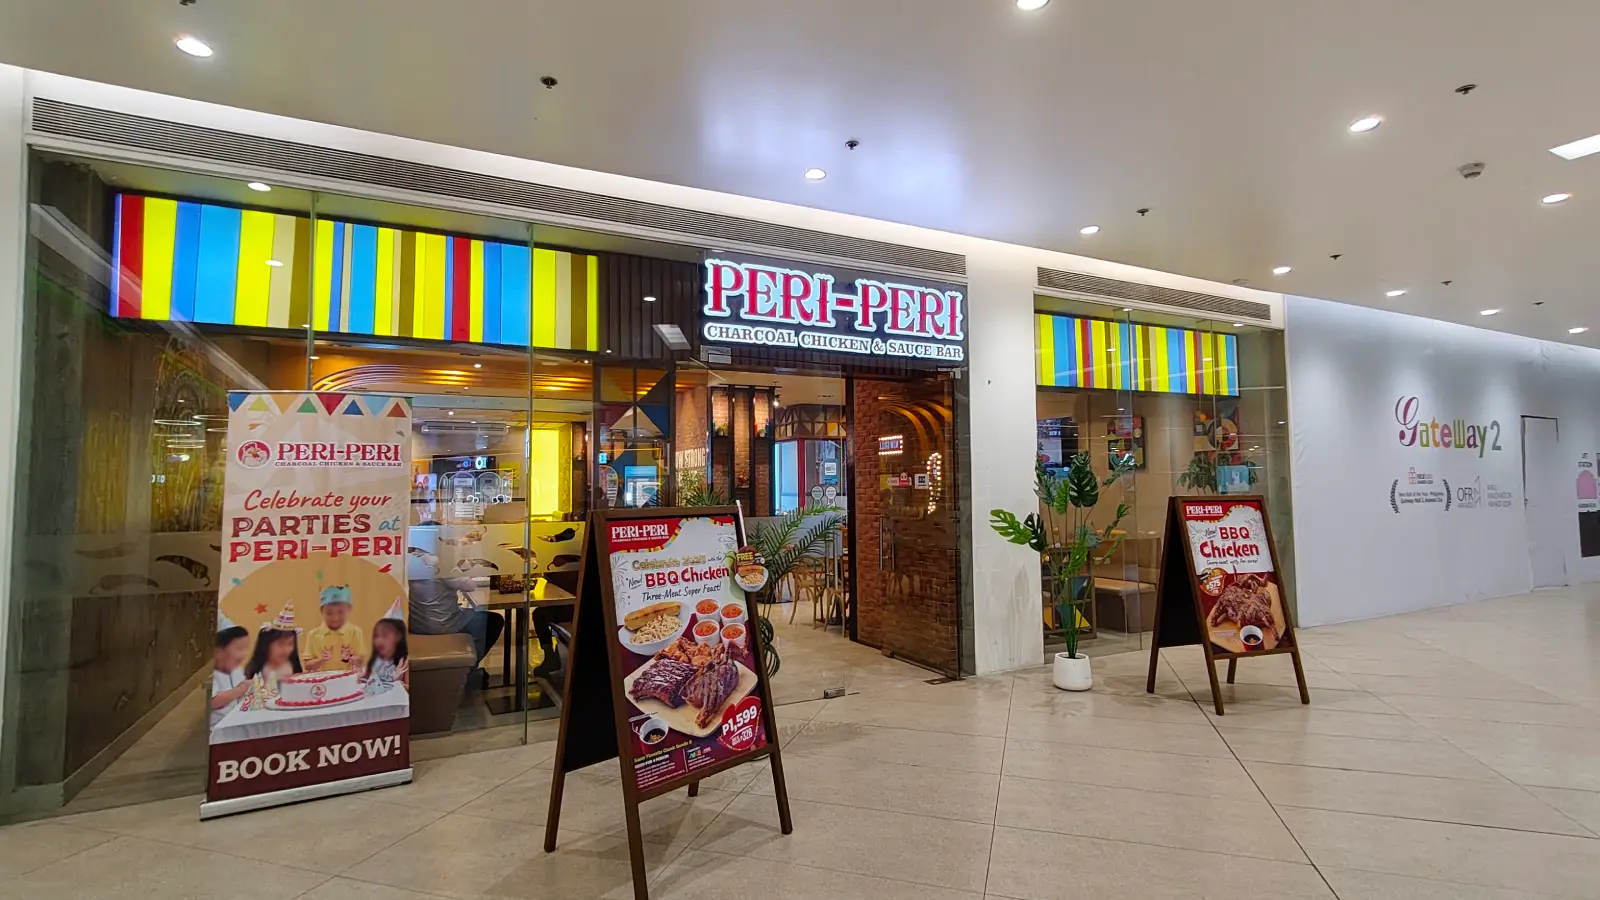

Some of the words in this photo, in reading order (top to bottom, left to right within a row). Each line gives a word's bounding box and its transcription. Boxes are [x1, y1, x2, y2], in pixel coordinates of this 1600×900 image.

[706, 261, 963, 338] PERI-PERI
[706, 325, 797, 345] CHARCOAL
[800, 333, 870, 352] CHICKEN
[873, 340, 885, 352] &
[888, 342, 932, 356] SAUCE
[935, 345, 962, 358] BAR
[1490, 420, 1503, 451] 2
[277, 442, 402, 462] PERI-PERI
[244, 488, 344, 511] Celebrate
[349, 494, 392, 514] your
[1186, 505, 1223, 515] PERI-PERI
[231, 513, 372, 538] PARTIES
[378, 516, 401, 532] at
[611, 524, 669, 539] PERI-PERI
[1219, 527, 1249, 539] BBQ
[229, 536, 402, 563] PERI-PERI
[1199, 540, 1260, 558] Chicken
[644, 570, 680, 588] BBQ
[681, 566, 730, 582] Chicken
[642, 588, 683, 603] Three-Meat
[216, 748, 311, 784] BOOK
[317, 734, 401, 768] NOW!
